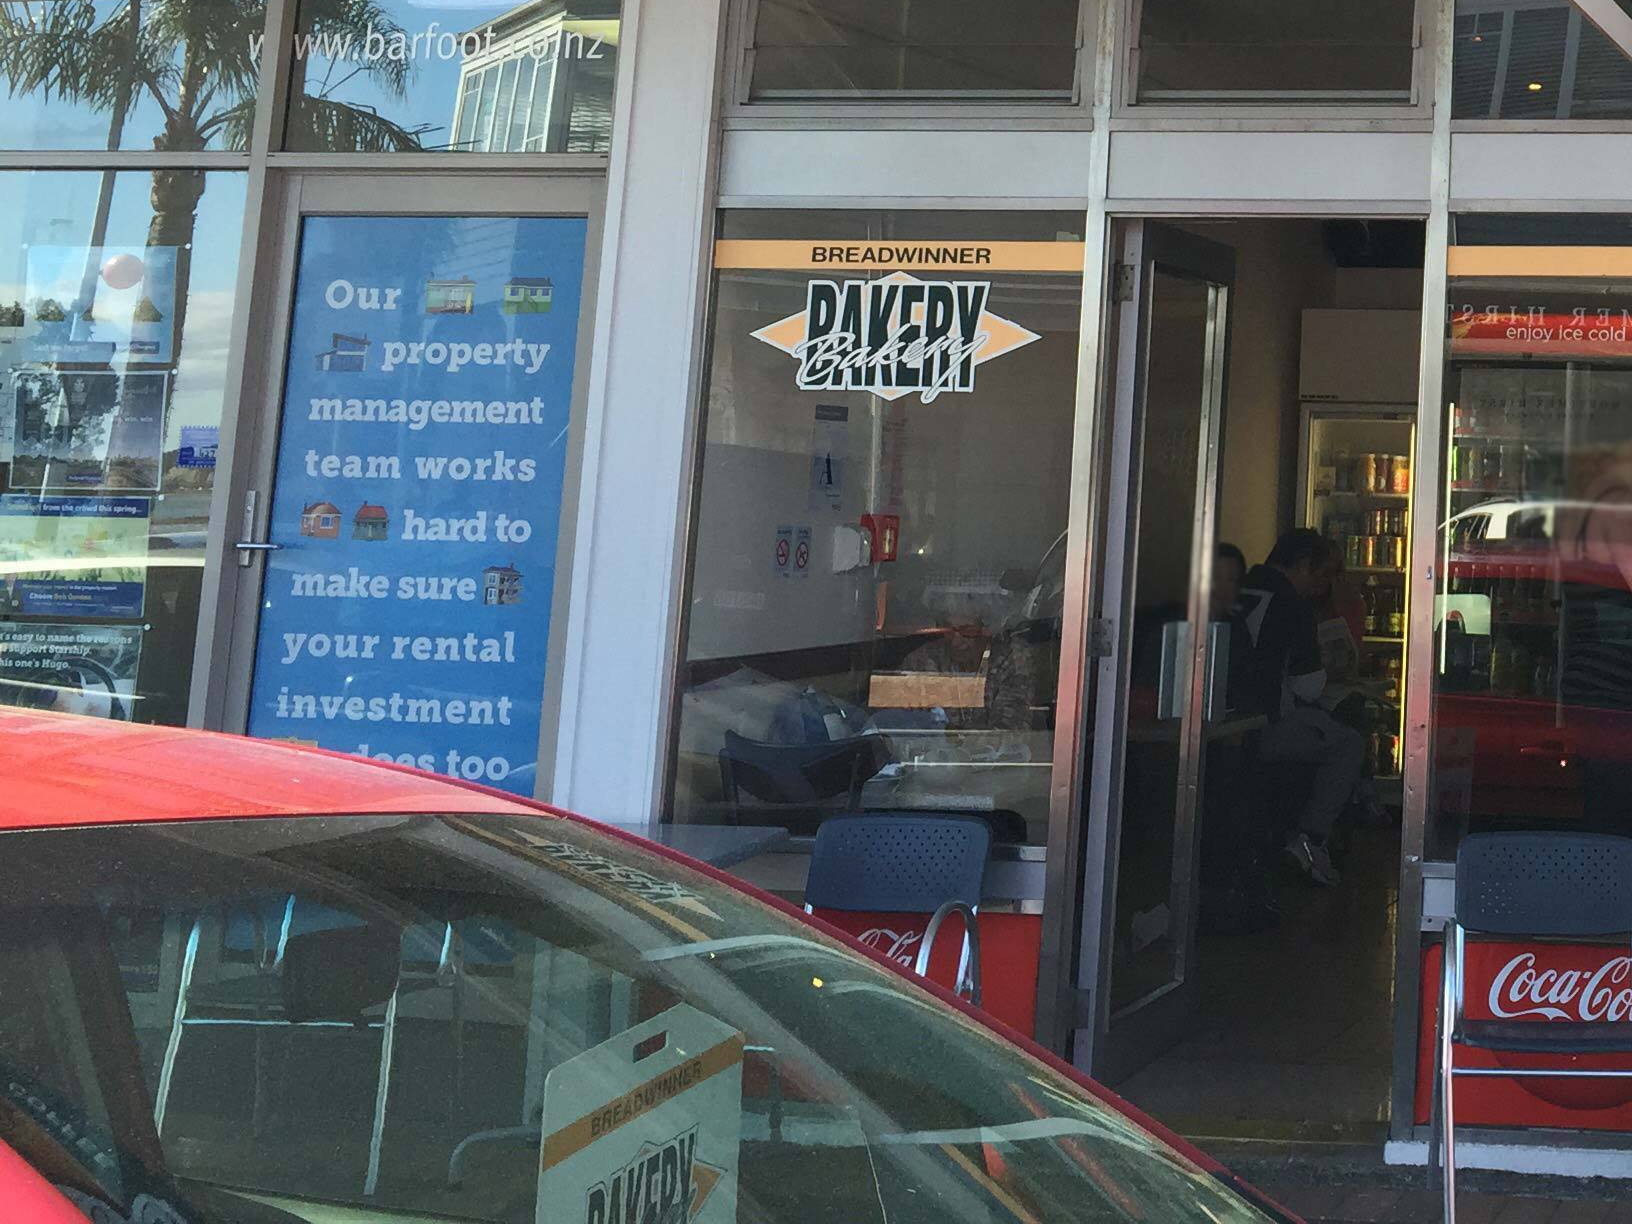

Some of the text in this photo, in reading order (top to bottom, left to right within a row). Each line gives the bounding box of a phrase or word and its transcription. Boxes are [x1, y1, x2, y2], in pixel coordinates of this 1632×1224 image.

[811, 246, 992, 265] BREADWINNER
[325, 280, 402, 311] Our
[808, 283, 987, 388] BAKERY
[1506, 324, 1626, 343] enjoy ice cold
[381, 338, 551, 373] property
[796, 323, 990, 402] Bakery
[308, 395, 545, 431] management
[305, 449, 536, 482] team works
[402, 509, 532, 543] hard to
[291, 568, 477, 602] make sure
[36, 632, 46, 642] to
[47, 634, 74, 642] name
[281, 631, 516, 665] your rental
[276, 687, 513, 726] investment
[446, 749, 509, 781] too
[590, 1060, 703, 1137] BREADWINNER
